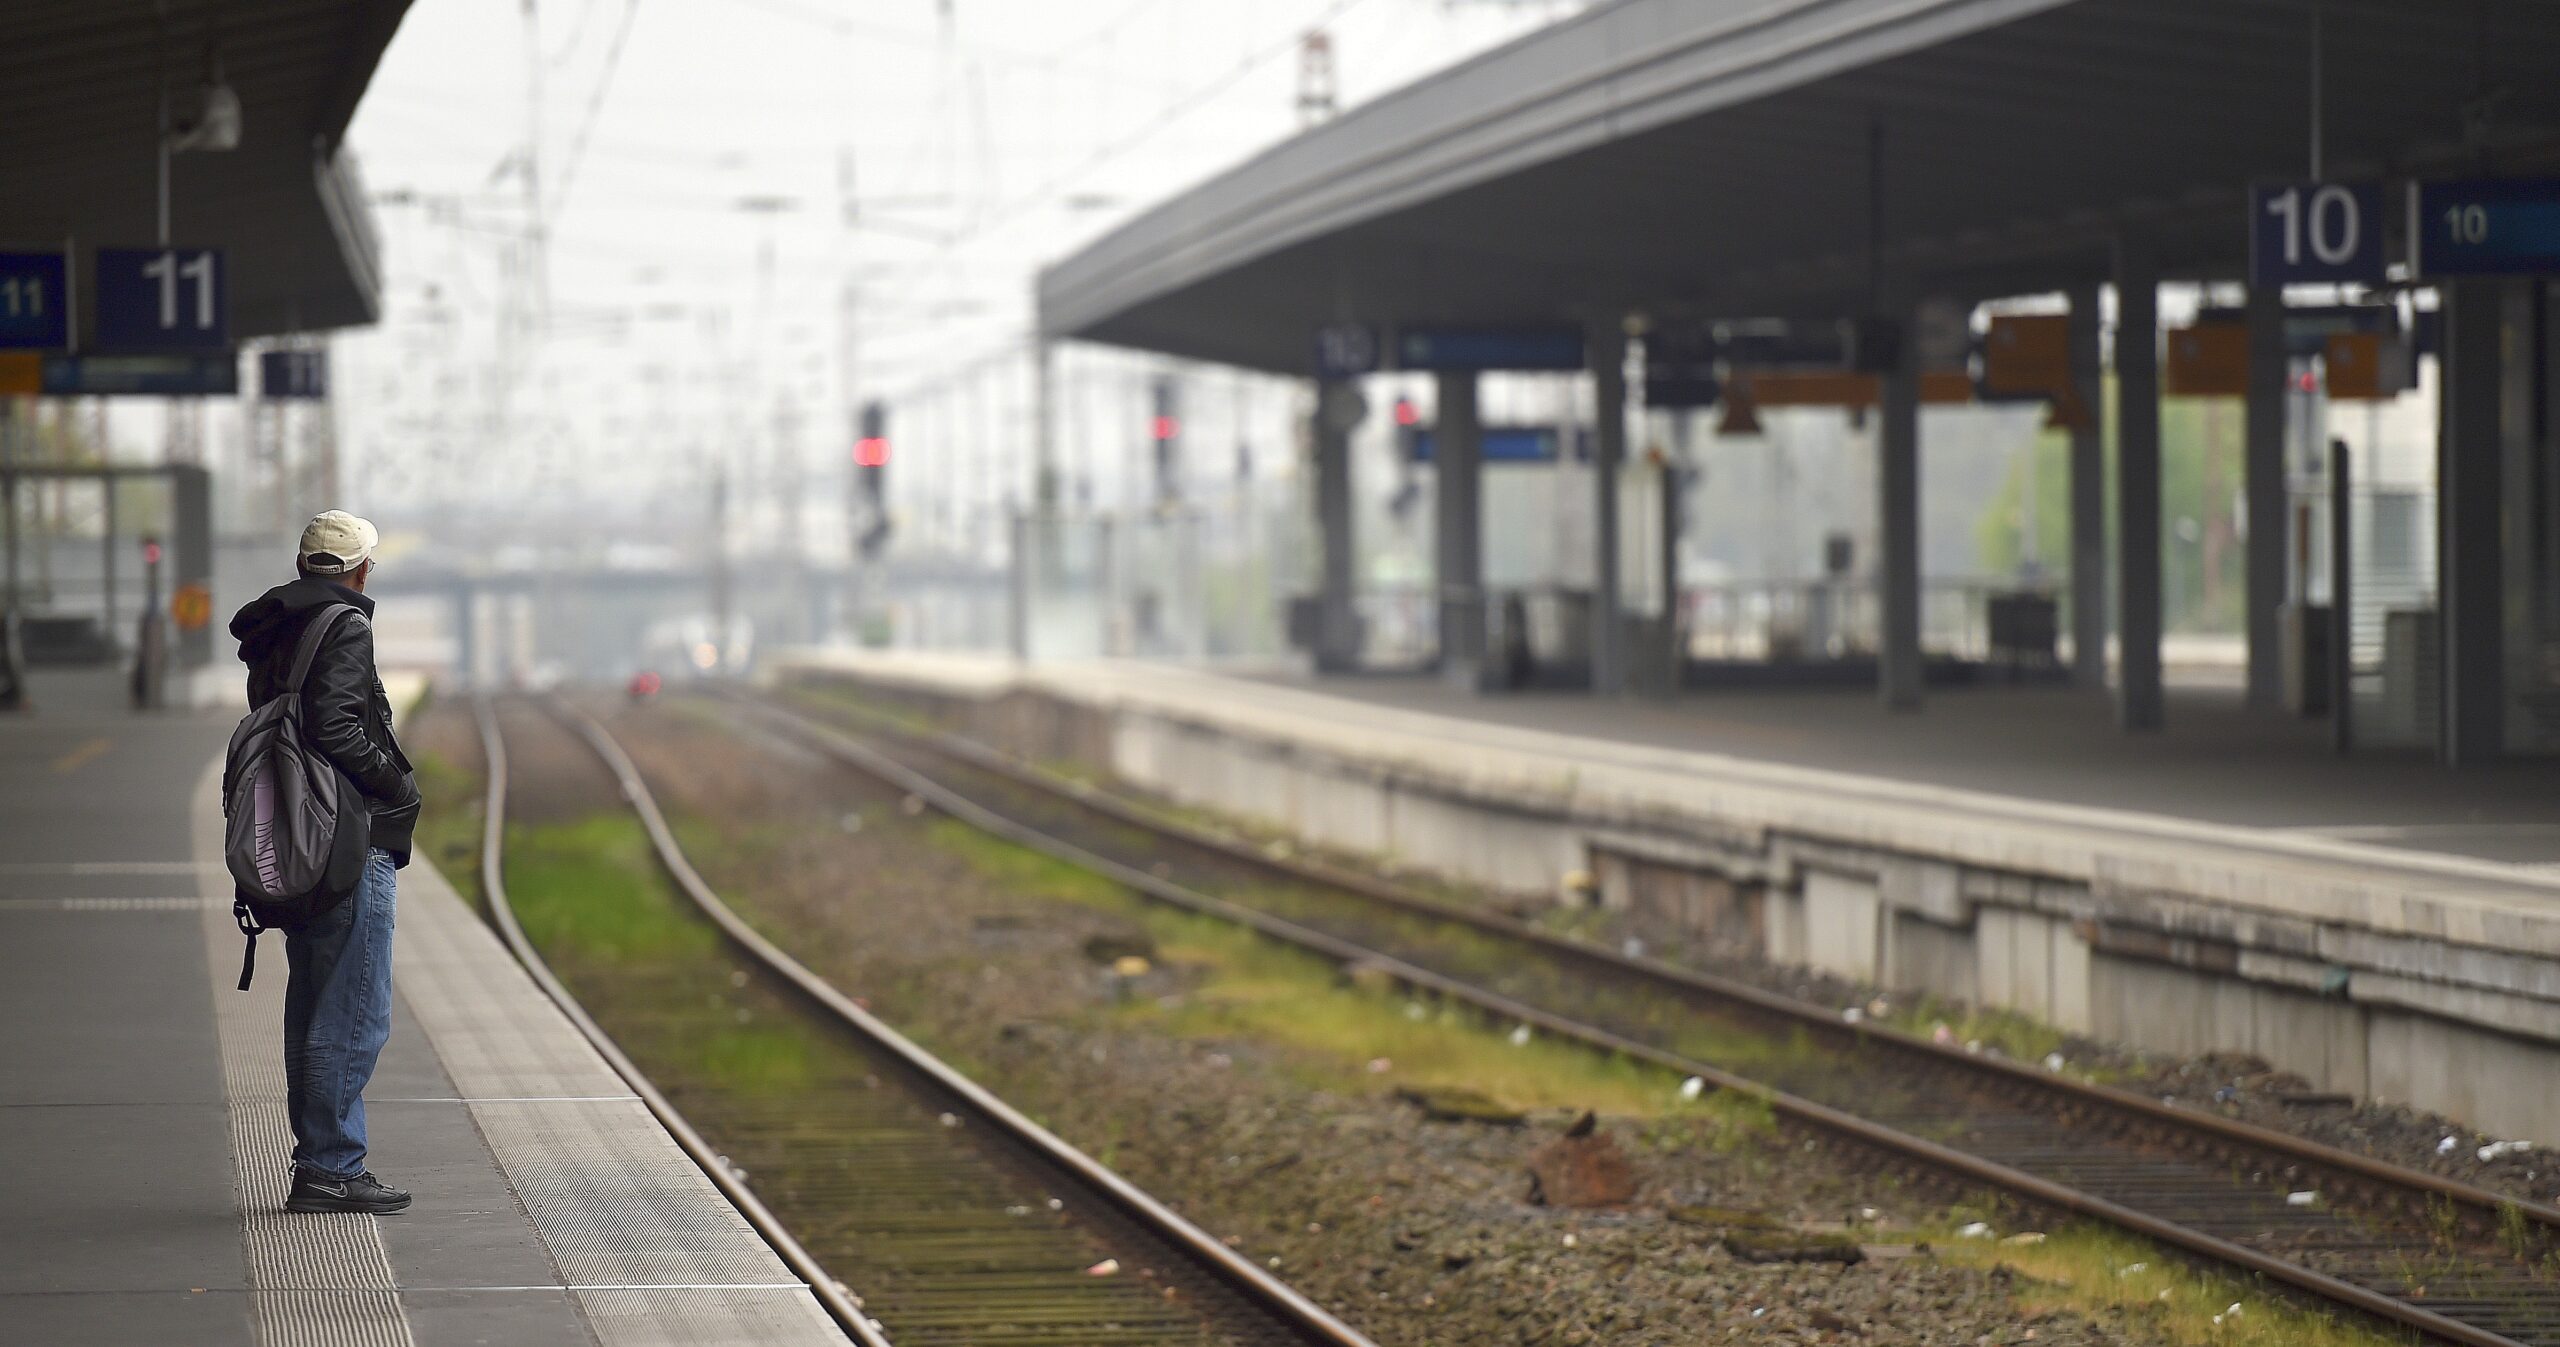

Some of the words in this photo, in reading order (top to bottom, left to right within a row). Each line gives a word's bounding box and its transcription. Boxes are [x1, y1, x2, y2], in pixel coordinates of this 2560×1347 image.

[2266, 185, 2361, 265] 10
[2444, 204, 2488, 244] 10
[1, 276, 45, 318] 11
[142, 250, 216, 330] 11
[254, 820, 280, 883] PUMA
